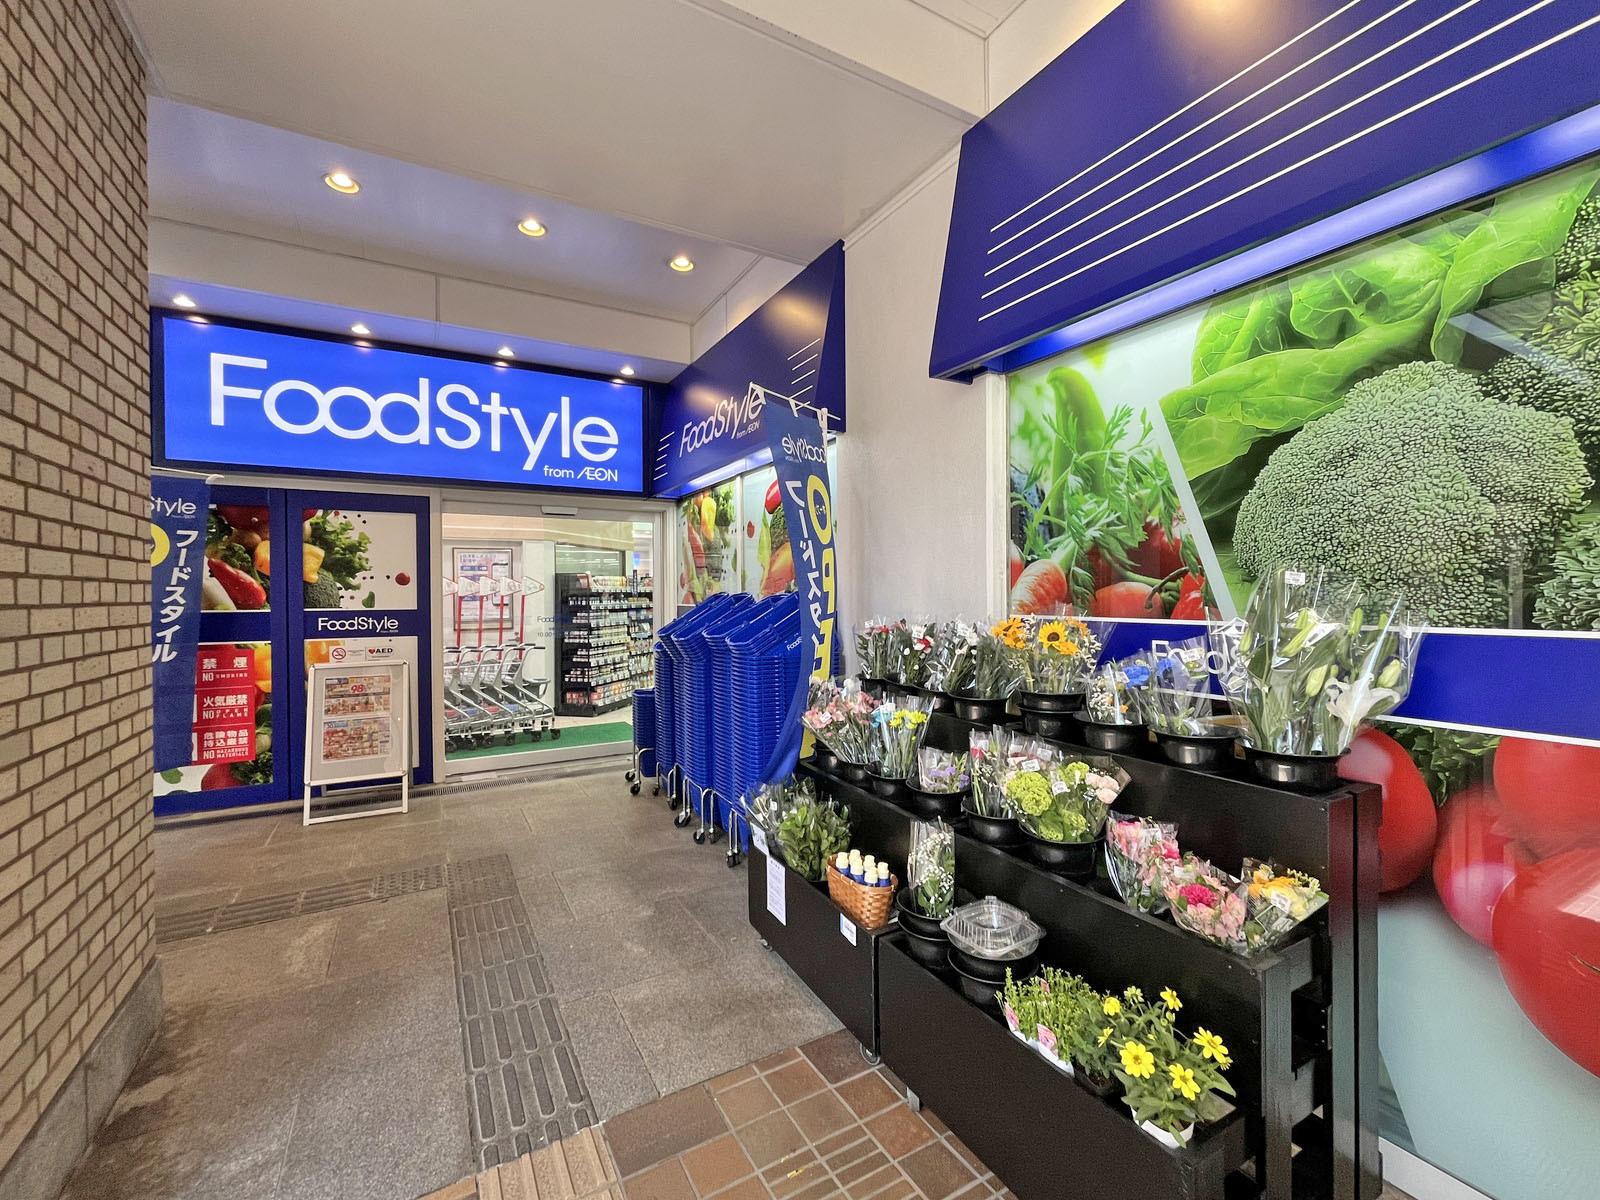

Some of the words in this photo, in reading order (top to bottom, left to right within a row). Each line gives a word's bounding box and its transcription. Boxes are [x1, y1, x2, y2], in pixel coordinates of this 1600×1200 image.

[210, 352, 619, 471] FoodStyle
[679, 384, 765, 458] FoodStyle
[543, 465, 574, 479] from
[152, 529, 199, 663] フードスタイル
[318, 616, 399, 633] FoodStyle
[202, 656, 248, 670] 禁煙
[202, 672, 214, 682] NO
[203, 694, 249, 708] 火気厳禁
[202, 710, 215, 720] NO
[203, 750, 215, 760] NO
